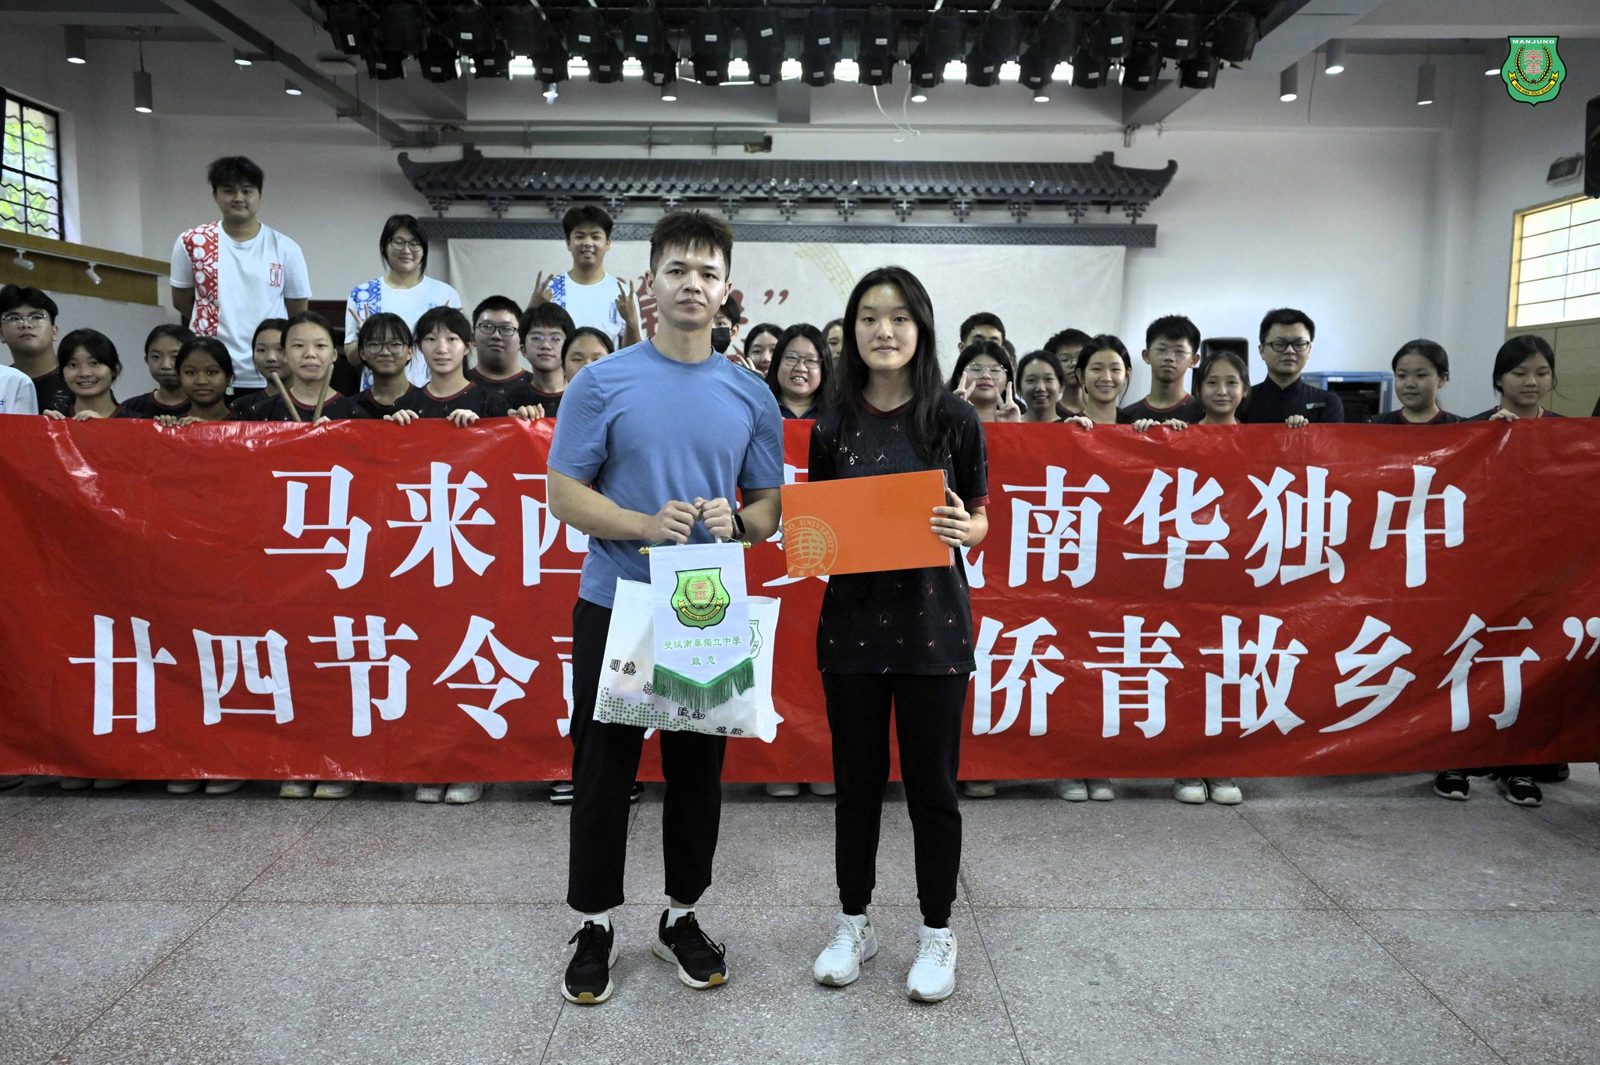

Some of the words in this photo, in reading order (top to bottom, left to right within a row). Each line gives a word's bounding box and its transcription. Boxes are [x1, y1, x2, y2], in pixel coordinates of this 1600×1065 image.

[799, 518, 835, 555] UNIVERSITY
[963, 456, 1467, 589] 南华独中
